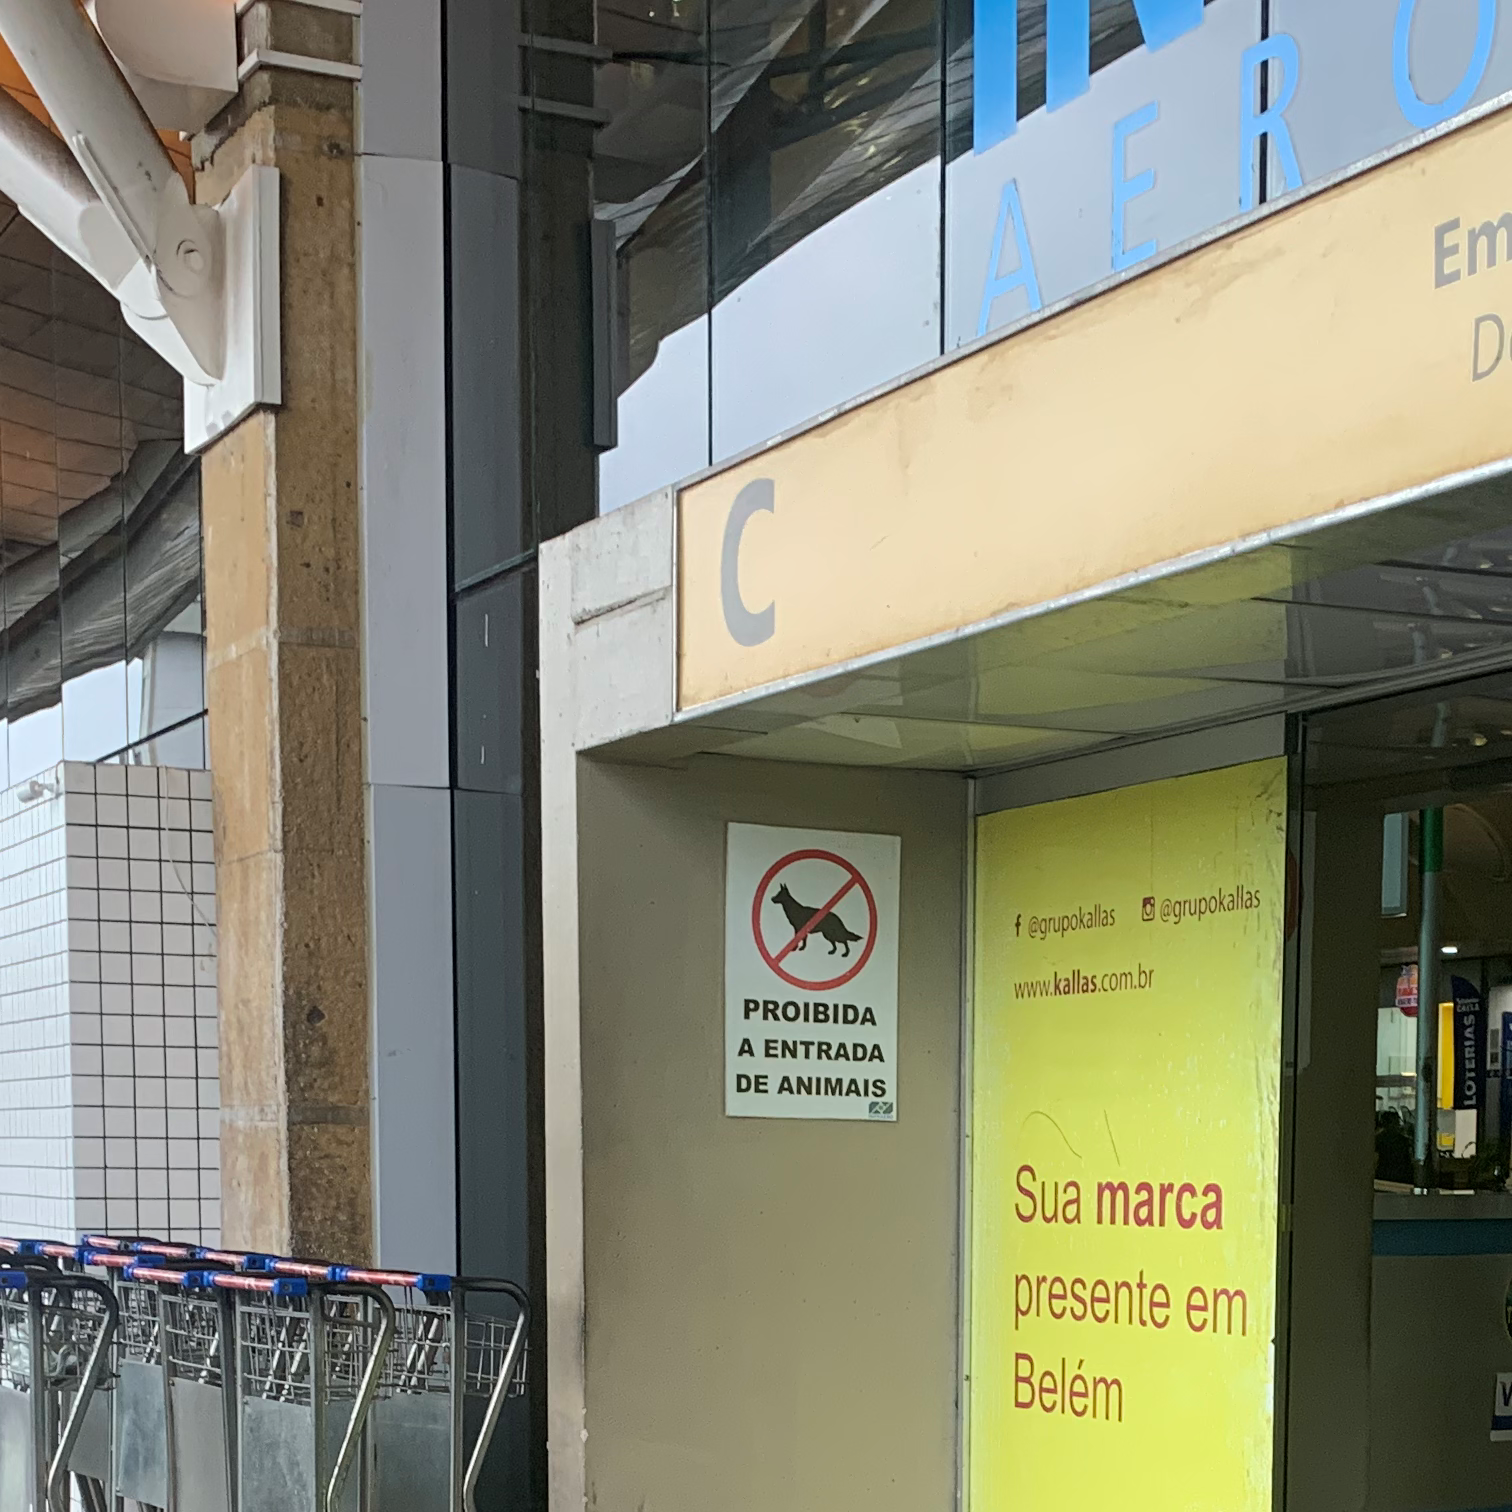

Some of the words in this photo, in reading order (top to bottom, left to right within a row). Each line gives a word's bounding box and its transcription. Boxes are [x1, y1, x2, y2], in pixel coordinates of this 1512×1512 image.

[720, 478, 775, 647] C
[1028, 903, 1116, 940] @grupokallas
[1159, 884, 1261, 925] @grupokallas
[1014, 963, 1155, 1000] www.kallas.com.br
[743, 998, 877, 1027] PROIBIDA
[737, 1037, 755, 1058] A
[764, 1038, 885, 1063] ENTRADA
[1463, 1014, 1478, 1106] LOTERIAS
[736, 1073, 769, 1094] DE
[777, 1075, 887, 1098] ANIMAIS
[1014, 1164, 1081, 1225] Sua
[1096, 1181, 1223, 1231] marca
[1014, 1268, 1171, 1331] presente
[1185, 1285, 1247, 1337] em
[1014, 1352, 1123, 1423] Belém
